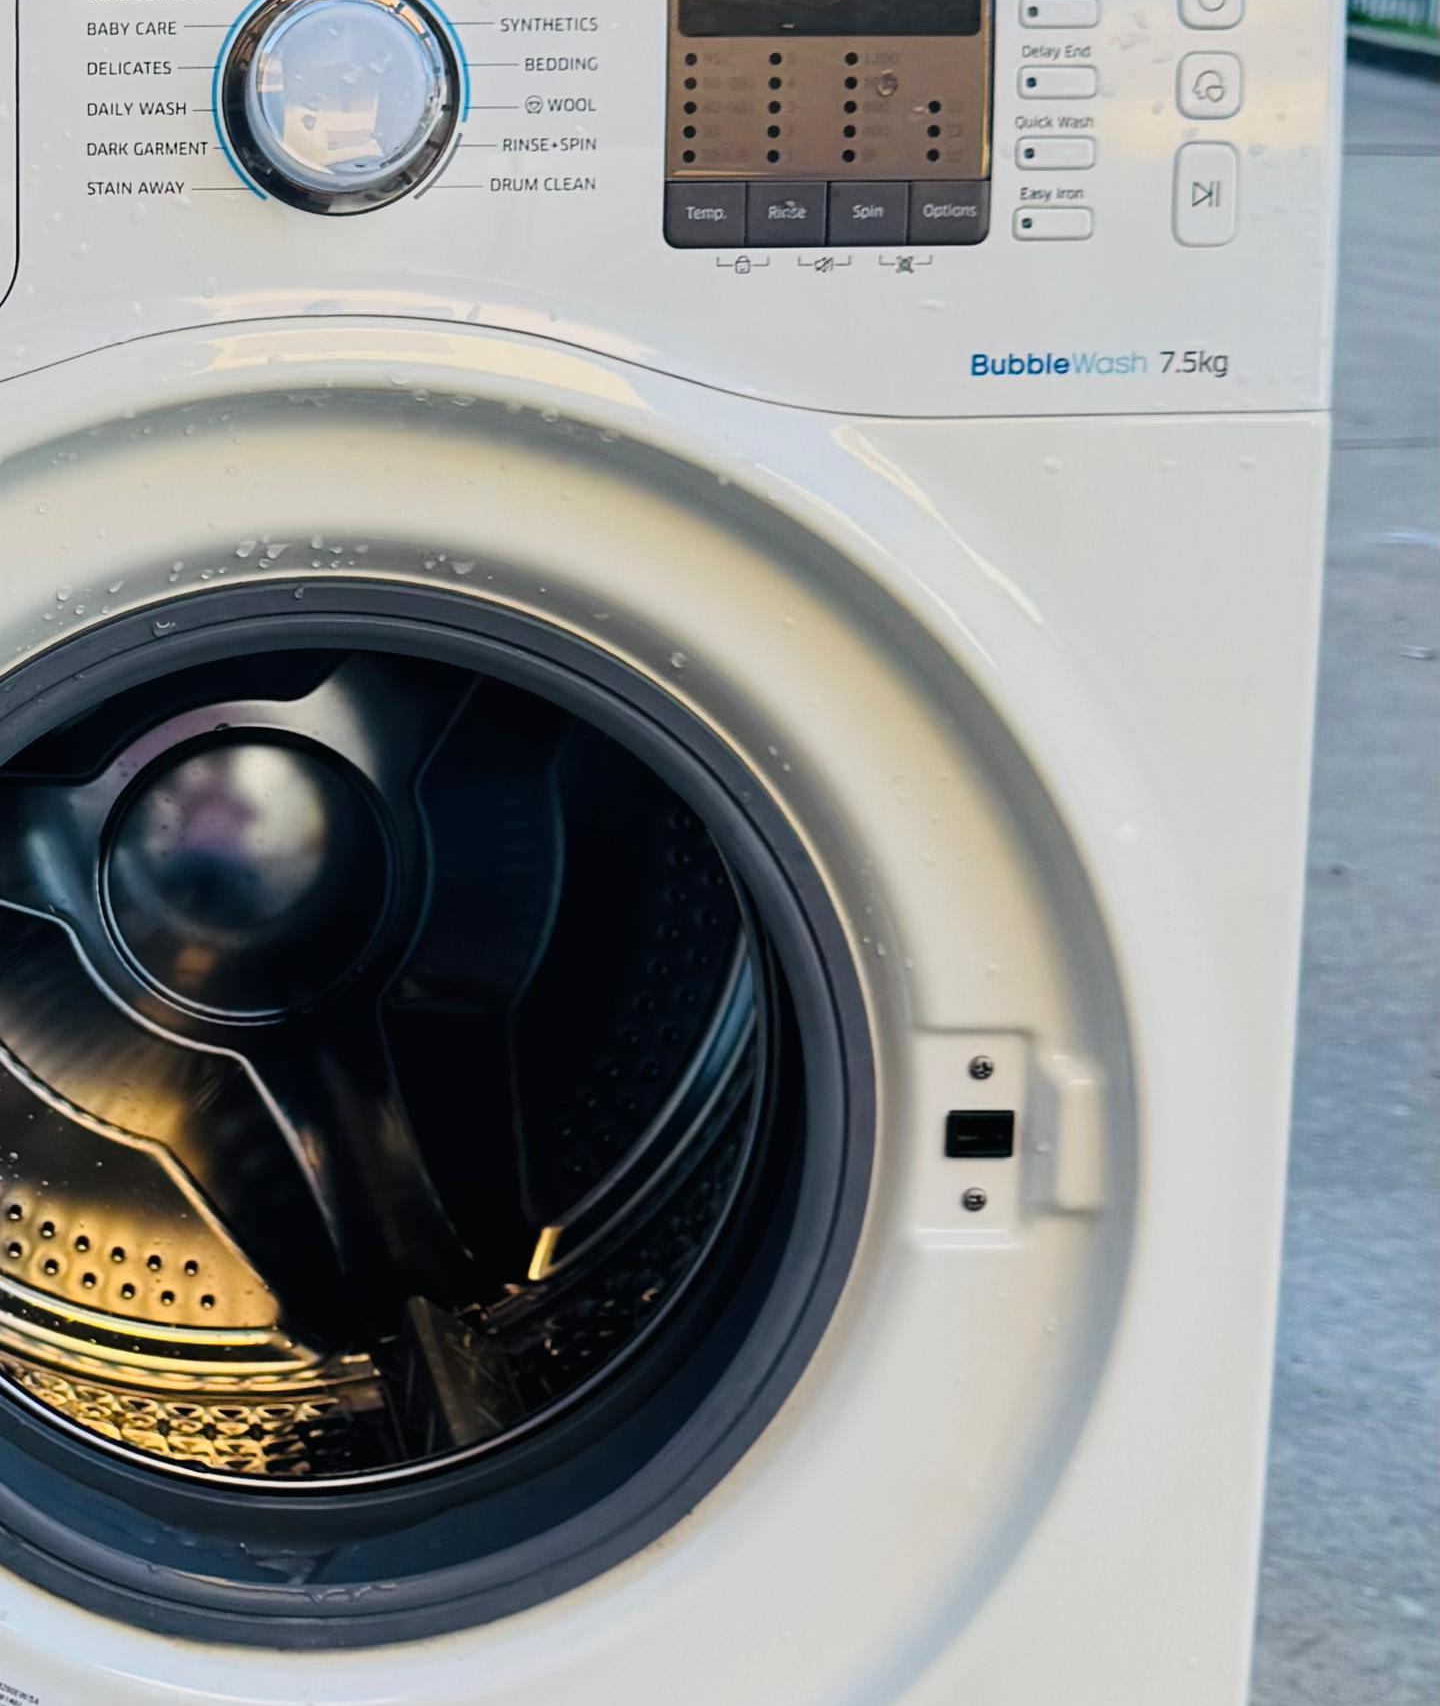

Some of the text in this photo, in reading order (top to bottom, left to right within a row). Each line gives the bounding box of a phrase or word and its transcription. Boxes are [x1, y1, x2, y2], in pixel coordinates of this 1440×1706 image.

[87, 21, 177, 36] BABY CARE
[500, 17, 599, 33] SYNTHETICS
[1021, 44, 1092, 61] Delay End
[87, 61, 172, 76] DELICATES
[524, 57, 598, 72] BEDDING
[87, 101, 187, 117] DAILY WASH
[547, 97, 597, 112] WOOL
[1014, 115, 1095, 130] Quick Wash
[87, 141, 209, 157] DARK GARMENT
[87, 181, 185, 196] STAIN AWAY
[490, 177, 596, 192] DRUM CLEAN
[1019, 186, 1085, 202] Easy Iron
[685, 204, 728, 222] Temp.
[851, 203, 884, 222] Spin
[922, 202, 978, 220] Options
[970, 350, 1230, 379] BubbleWash 7.5kg
